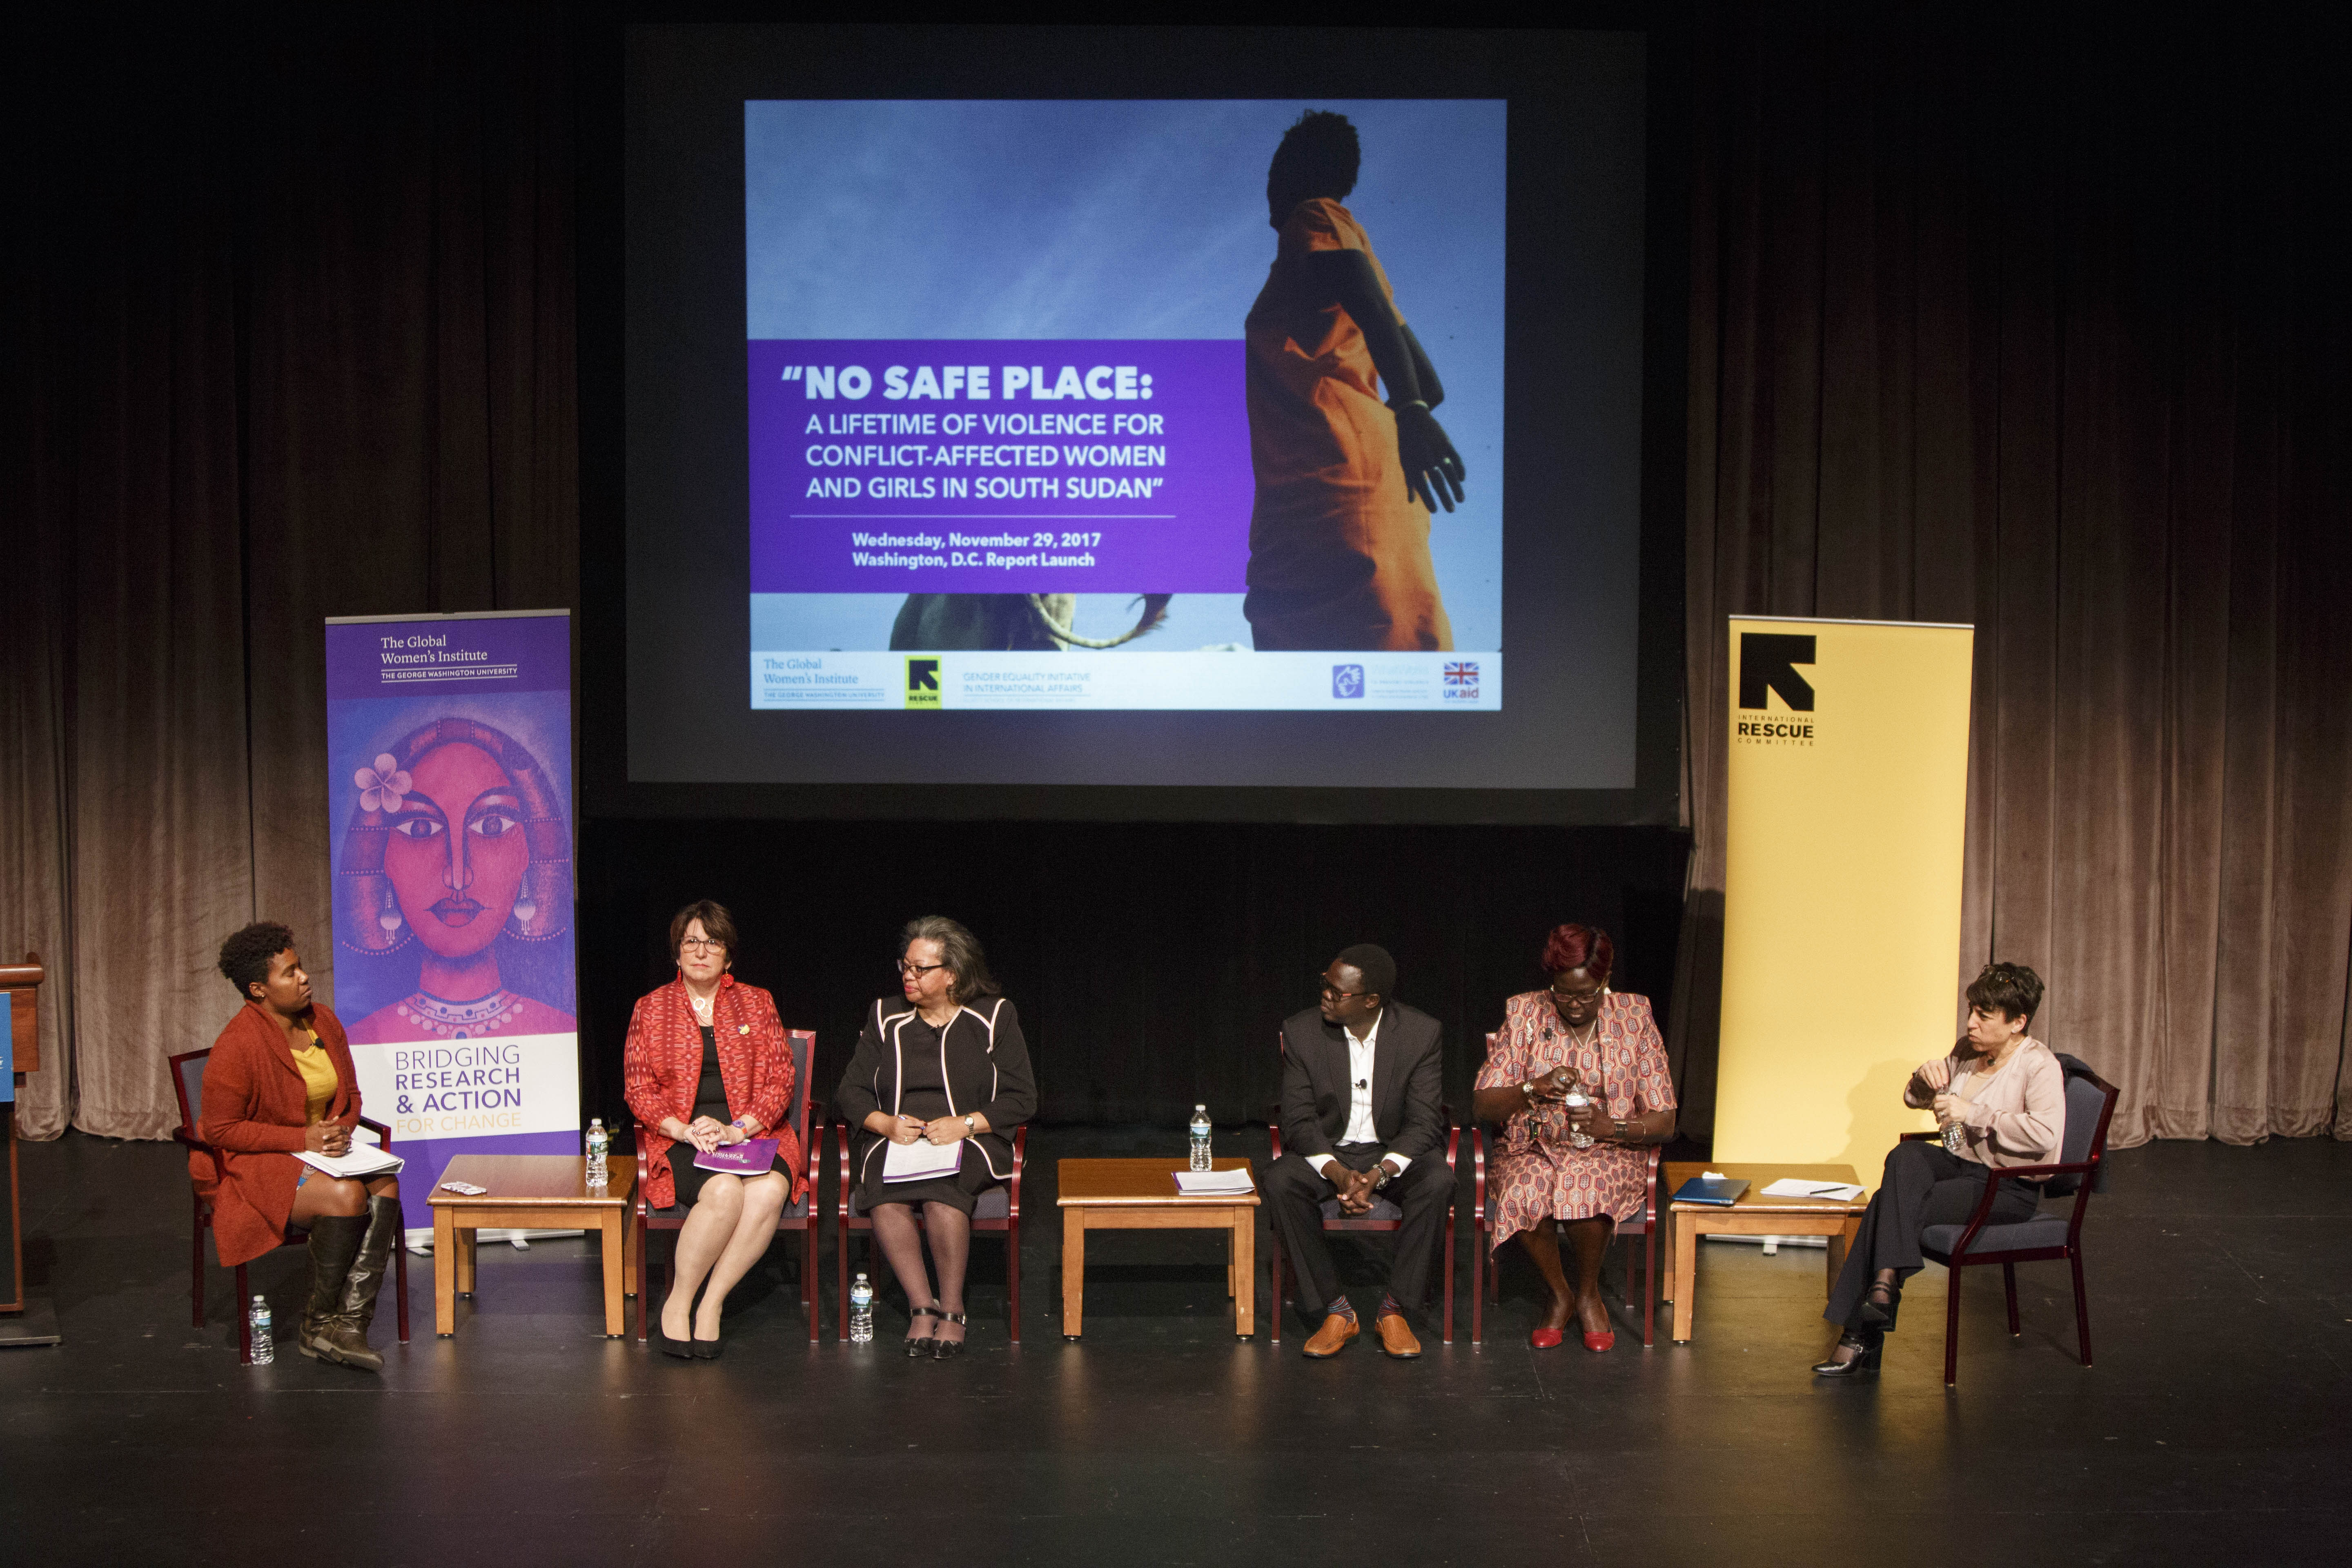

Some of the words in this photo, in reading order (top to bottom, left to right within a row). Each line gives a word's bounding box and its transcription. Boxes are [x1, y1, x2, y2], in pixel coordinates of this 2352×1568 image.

[882, 366, 991, 400] SAFE
[1003, 366, 1153, 400] PLACE:
[805, 414, 824, 435] A
[830, 414, 936, 435] LIFETIME
[942, 414, 976, 435] OF
[982, 414, 1106, 435] VIOLENCE
[1113, 414, 1163, 435] FOR
[806, 445, 1058, 466] CONFLICT-AFFECTED
[1063, 445, 1165, 466] WOMEN
[806, 477, 861, 498] AND
[868, 477, 935, 498] GIRLS
[943, 477, 967, 498] IN
[975, 477, 1058, 498] SOUTH
[852, 533, 946, 550] Wednesday,
[949, 533, 1029, 547] November
[1033, 533, 1058, 549] 29,
[1061, 533, 1101, 547] 2017
[852, 552, 948, 570] Washington,
[951, 552, 982, 567] D.C.
[986, 552, 1038, 570] Report
[1040, 552, 1095, 567] Launch
[381, 636, 404, 648] The
[408, 634, 446, 648] Global
[438, 649, 488, 662] Institute
[764, 658, 784, 669] The
[787, 658, 822, 669] Global
[397, 670, 426, 679] GEORGE
[428, 669, 475, 677] WASHINGTON
[477, 667, 517, 676] UNIVERSITY
[815, 674, 858, 684] Institute
[963, 673, 1000, 681] GENDER
[1003, 673, 1045, 681] EQUALITY
[1047, 673, 1091, 681] INITIATIVE
[1738, 722, 1814, 738] RESCUE
[1738, 738, 1813, 746] COMMITTEE
[396, 1045, 519, 1070] BRIDGING
[396, 1067, 519, 1090] RESEARCH
[396, 1095, 414, 1114] &
[423, 1089, 521, 1112] ACTION
[397, 1118, 434, 1134] FOR
[441, 1112, 521, 1131] CHANGE
